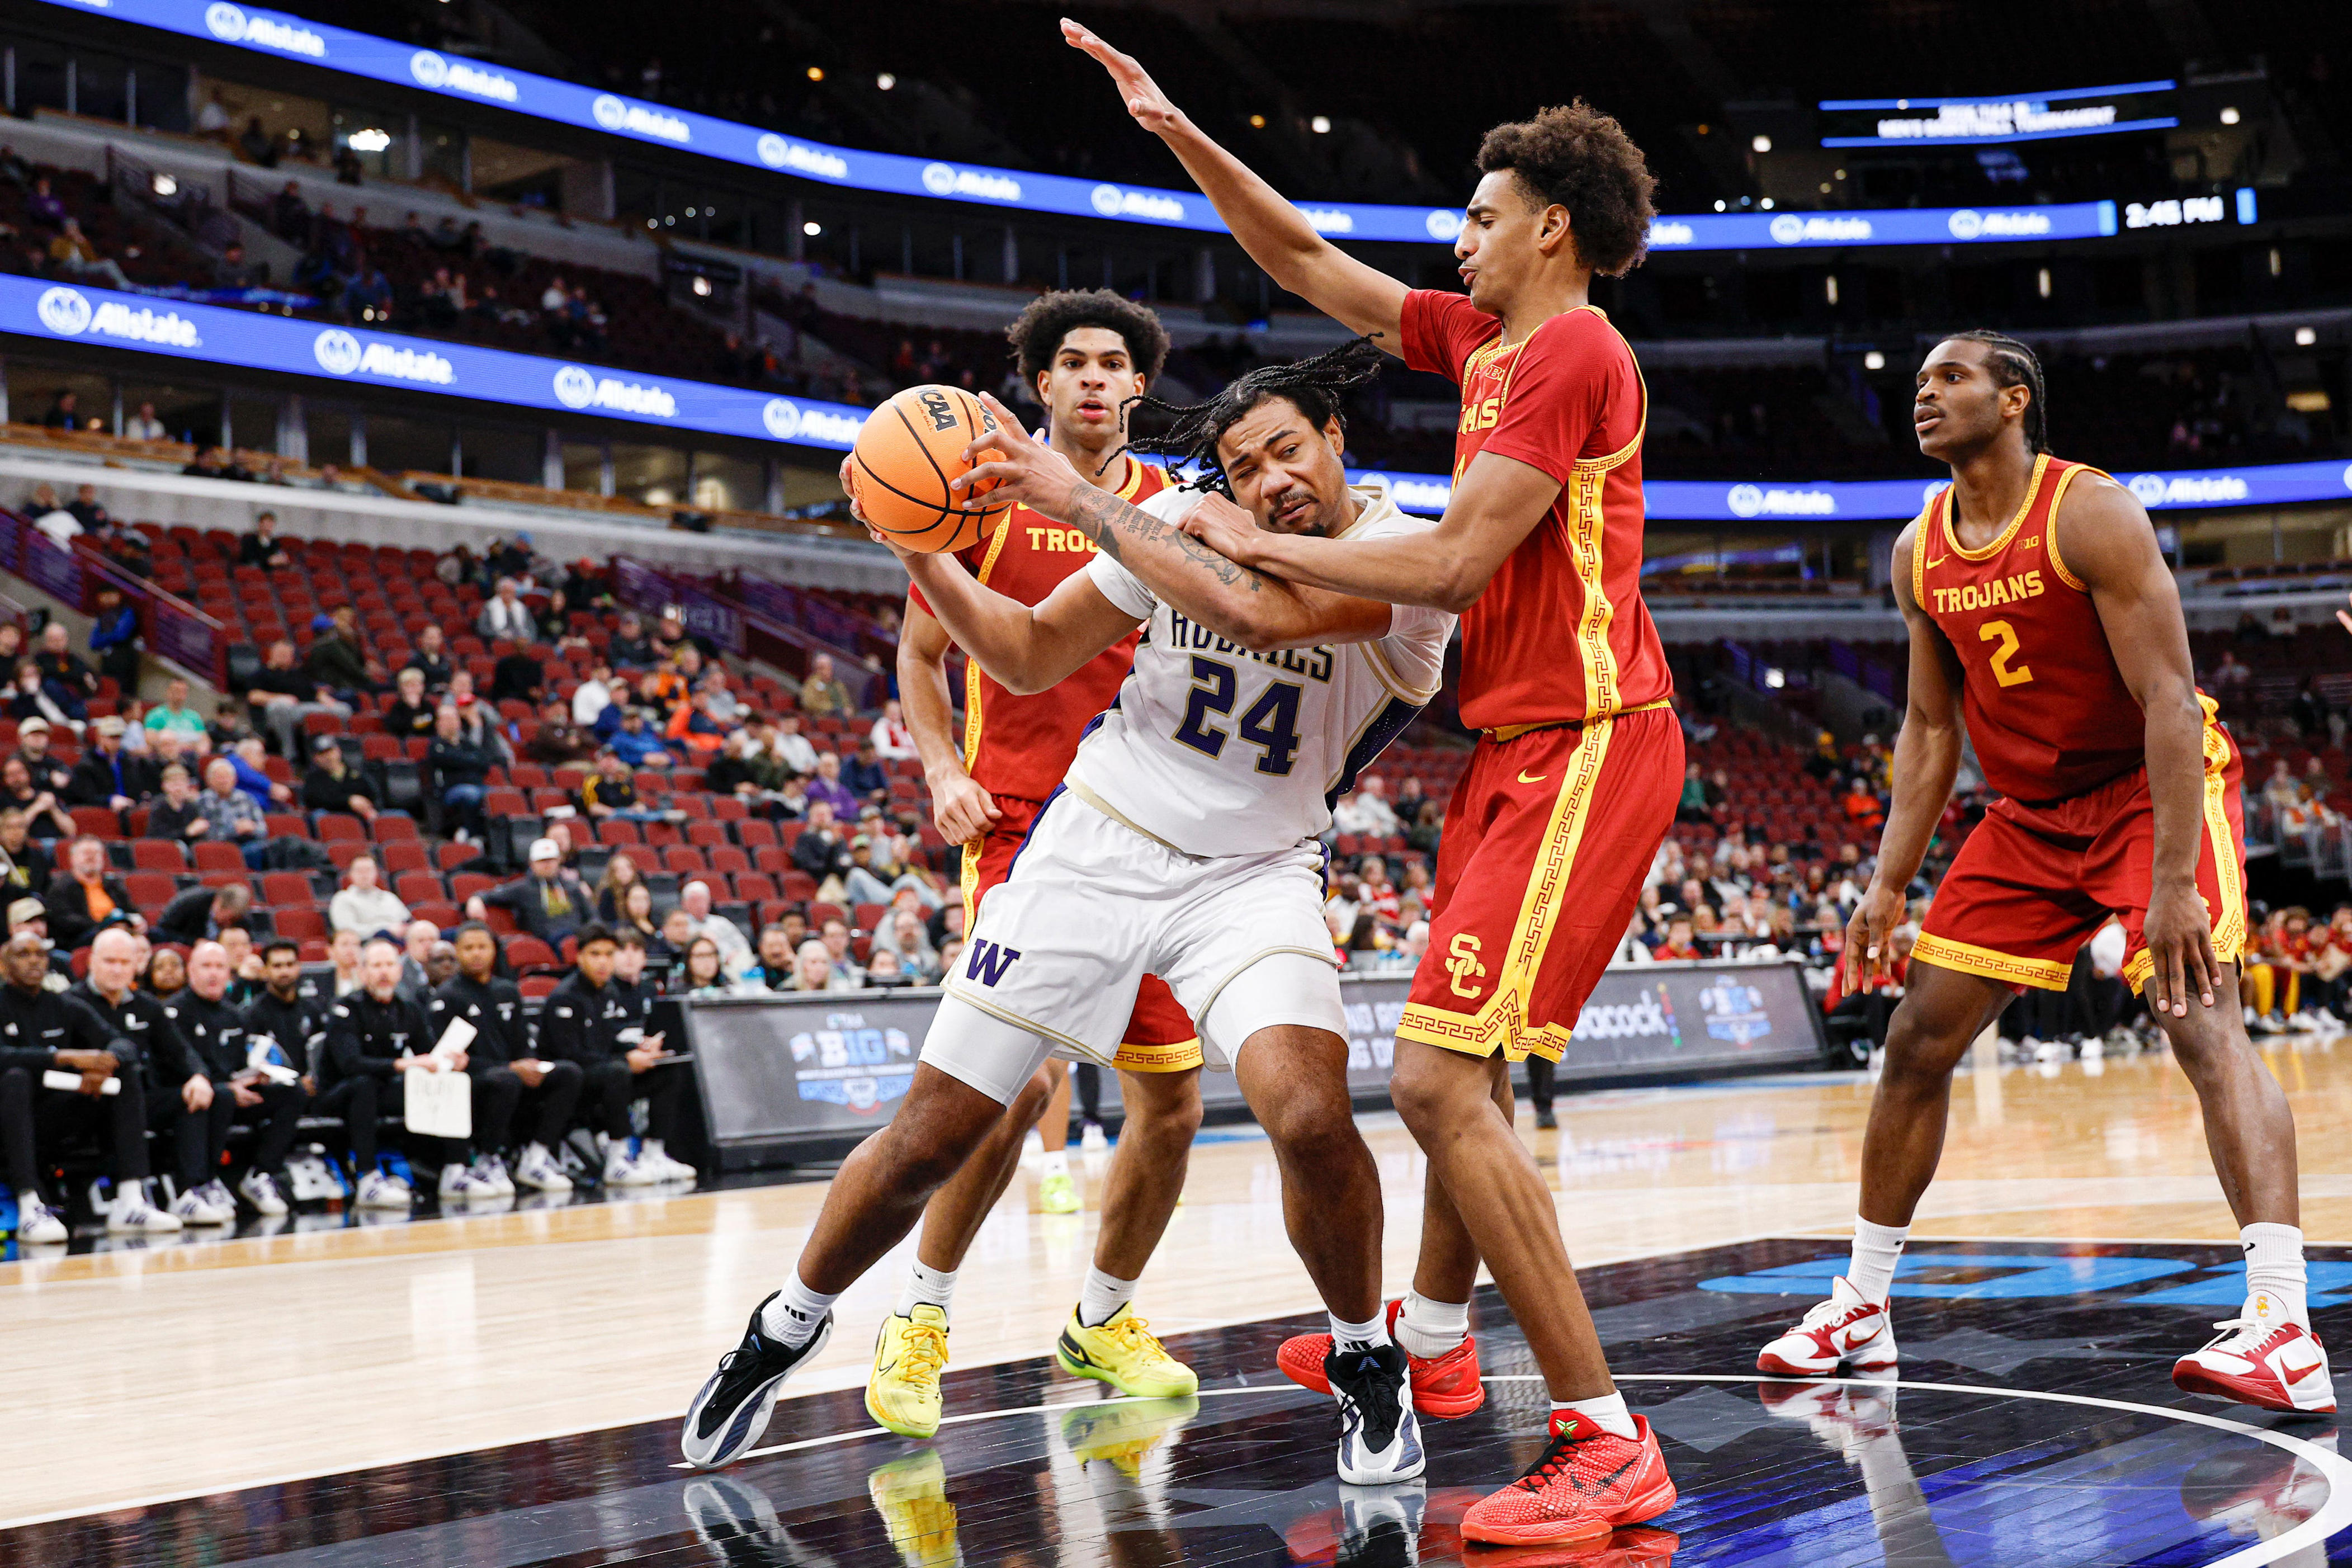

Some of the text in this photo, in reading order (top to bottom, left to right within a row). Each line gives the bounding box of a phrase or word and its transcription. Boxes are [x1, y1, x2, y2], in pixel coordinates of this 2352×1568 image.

[245, 17, 325, 57] Allstate
[2183, 196, 2223, 223] PM
[89, 301, 202, 348] Allstate
[358, 342, 456, 385] Allstate
[592, 379, 676, 418] Allstate
[2164, 476, 2248, 503] Allstate
[1933, 570, 2044, 613] TROJANS
[1978, 620, 2033, 687] 2
[1172, 653, 1304, 777] 24
[966, 938, 1021, 988] W
[1445, 933, 1486, 999] SC
[1566, 989, 1670, 1050] eacock
